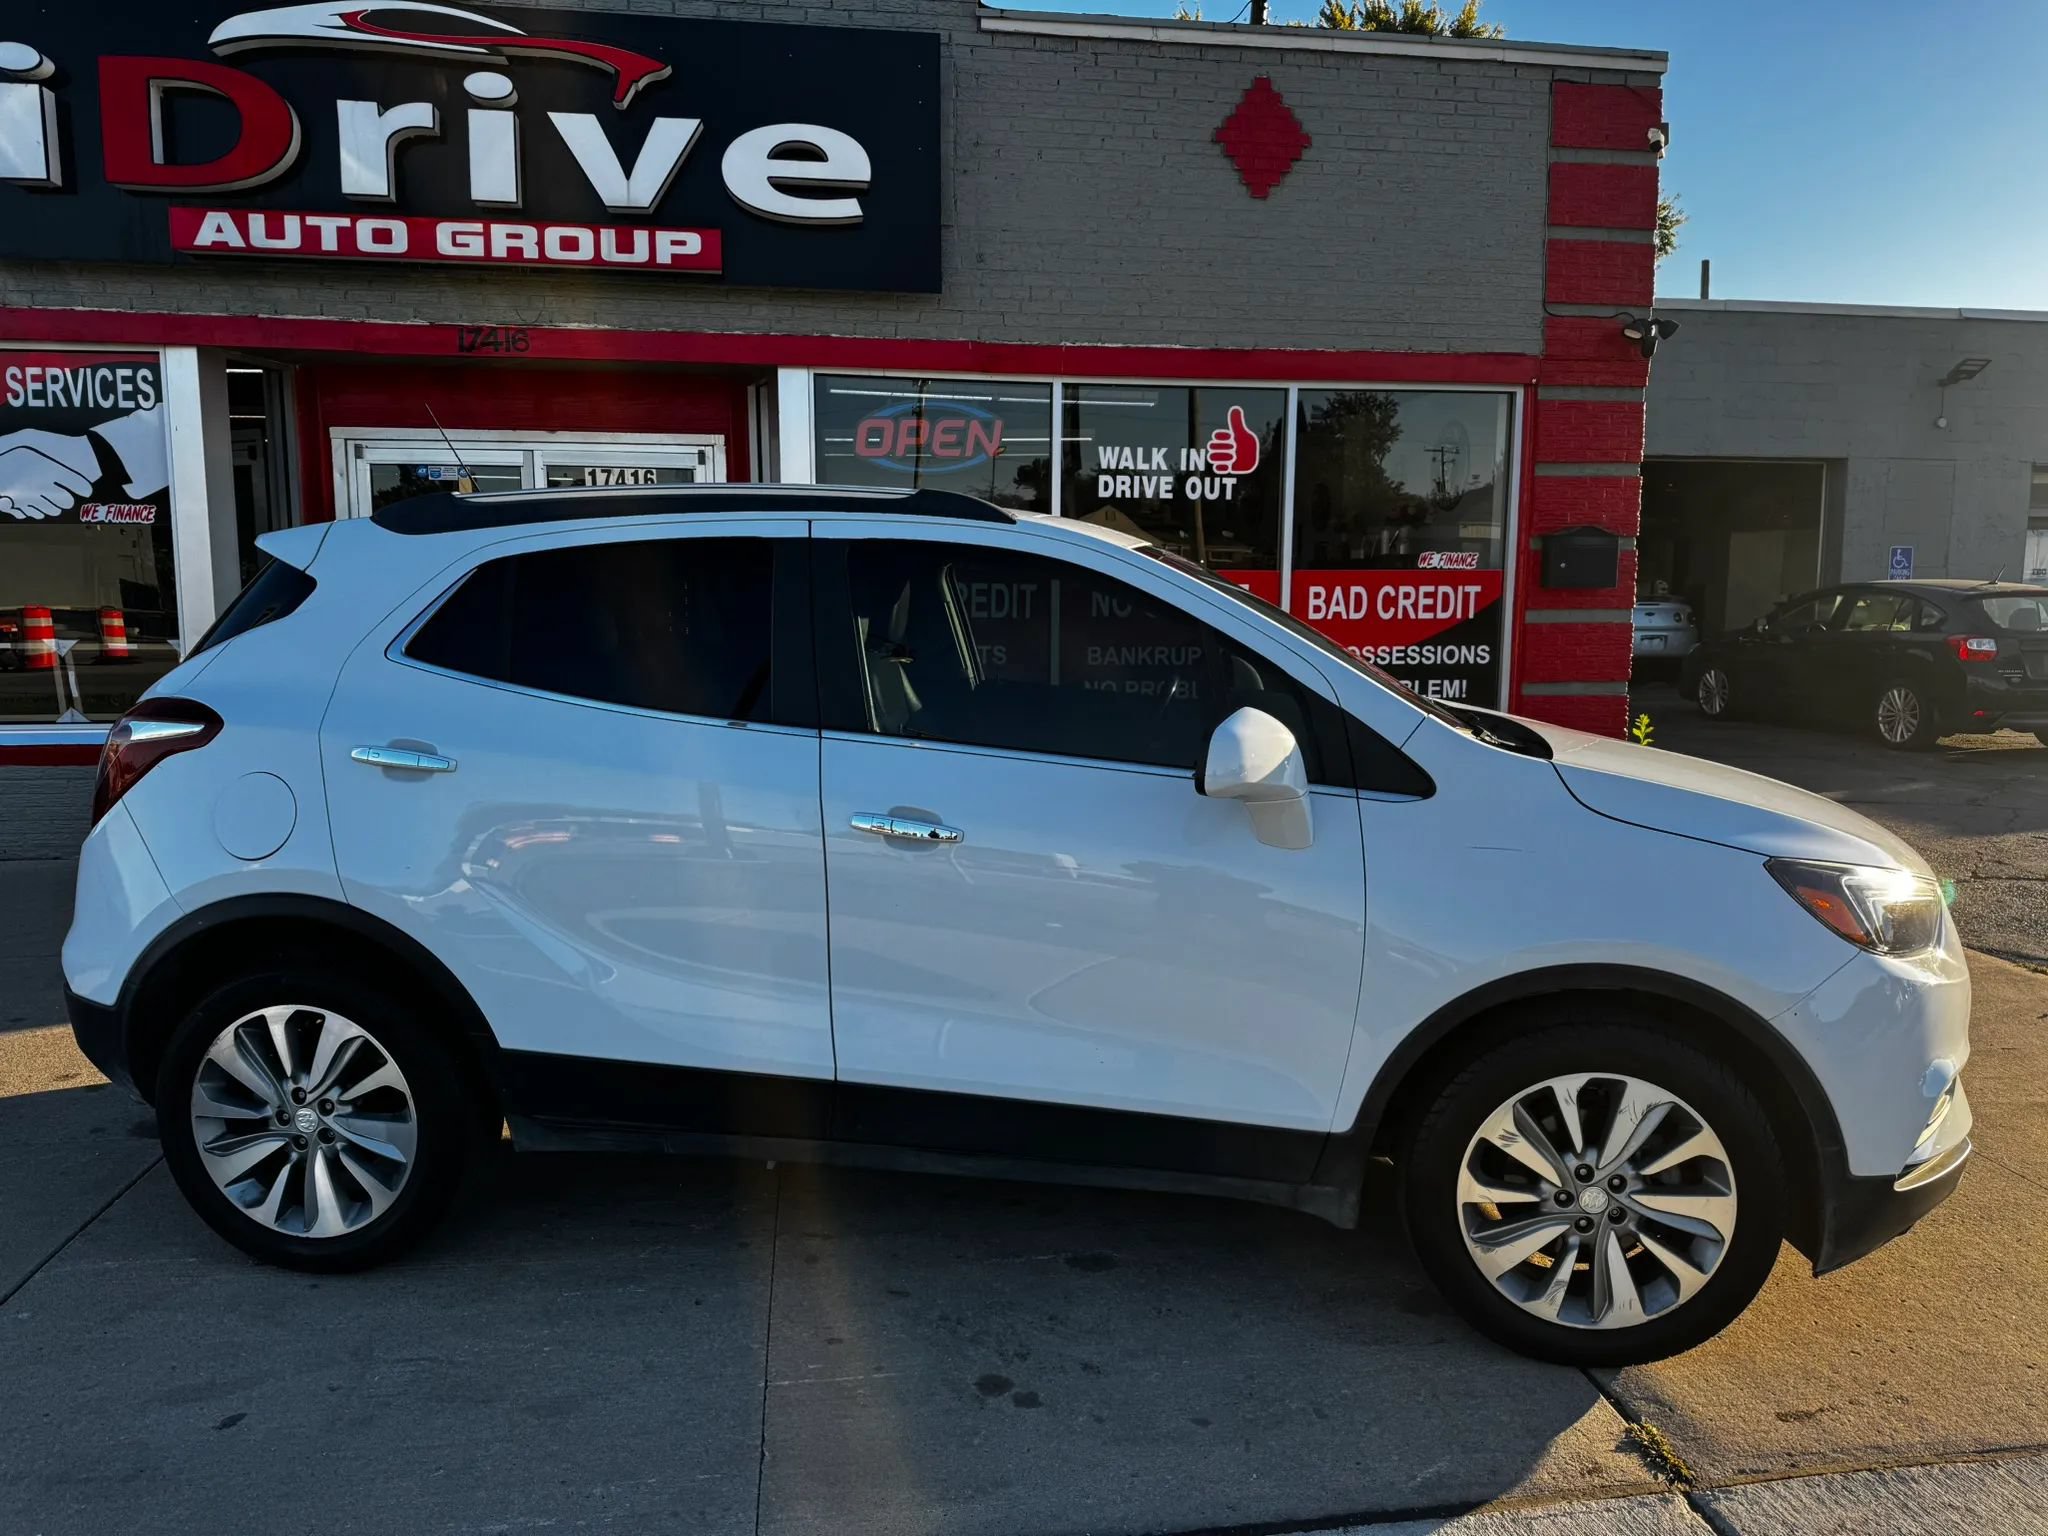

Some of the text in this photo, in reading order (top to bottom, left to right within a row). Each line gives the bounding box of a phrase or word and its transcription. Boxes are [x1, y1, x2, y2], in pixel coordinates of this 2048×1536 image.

[0, 41, 871, 219] iDrive
[193, 211, 701, 265] AUTO GROUP
[458, 327, 530, 352] 17416
[5, 366, 156, 409] SERVICES
[855, 418, 1005, 458] OPEN
[1098, 445, 1206, 472] WALK IN
[588, 468, 656, 486] 17416
[1098, 474, 1238, 501] DRIVE OUT
[80, 503, 156, 523] WE FINANCE
[1418, 552, 1479, 569] WE FINANCE
[1308, 585, 1482, 620] BAD CREDIT
